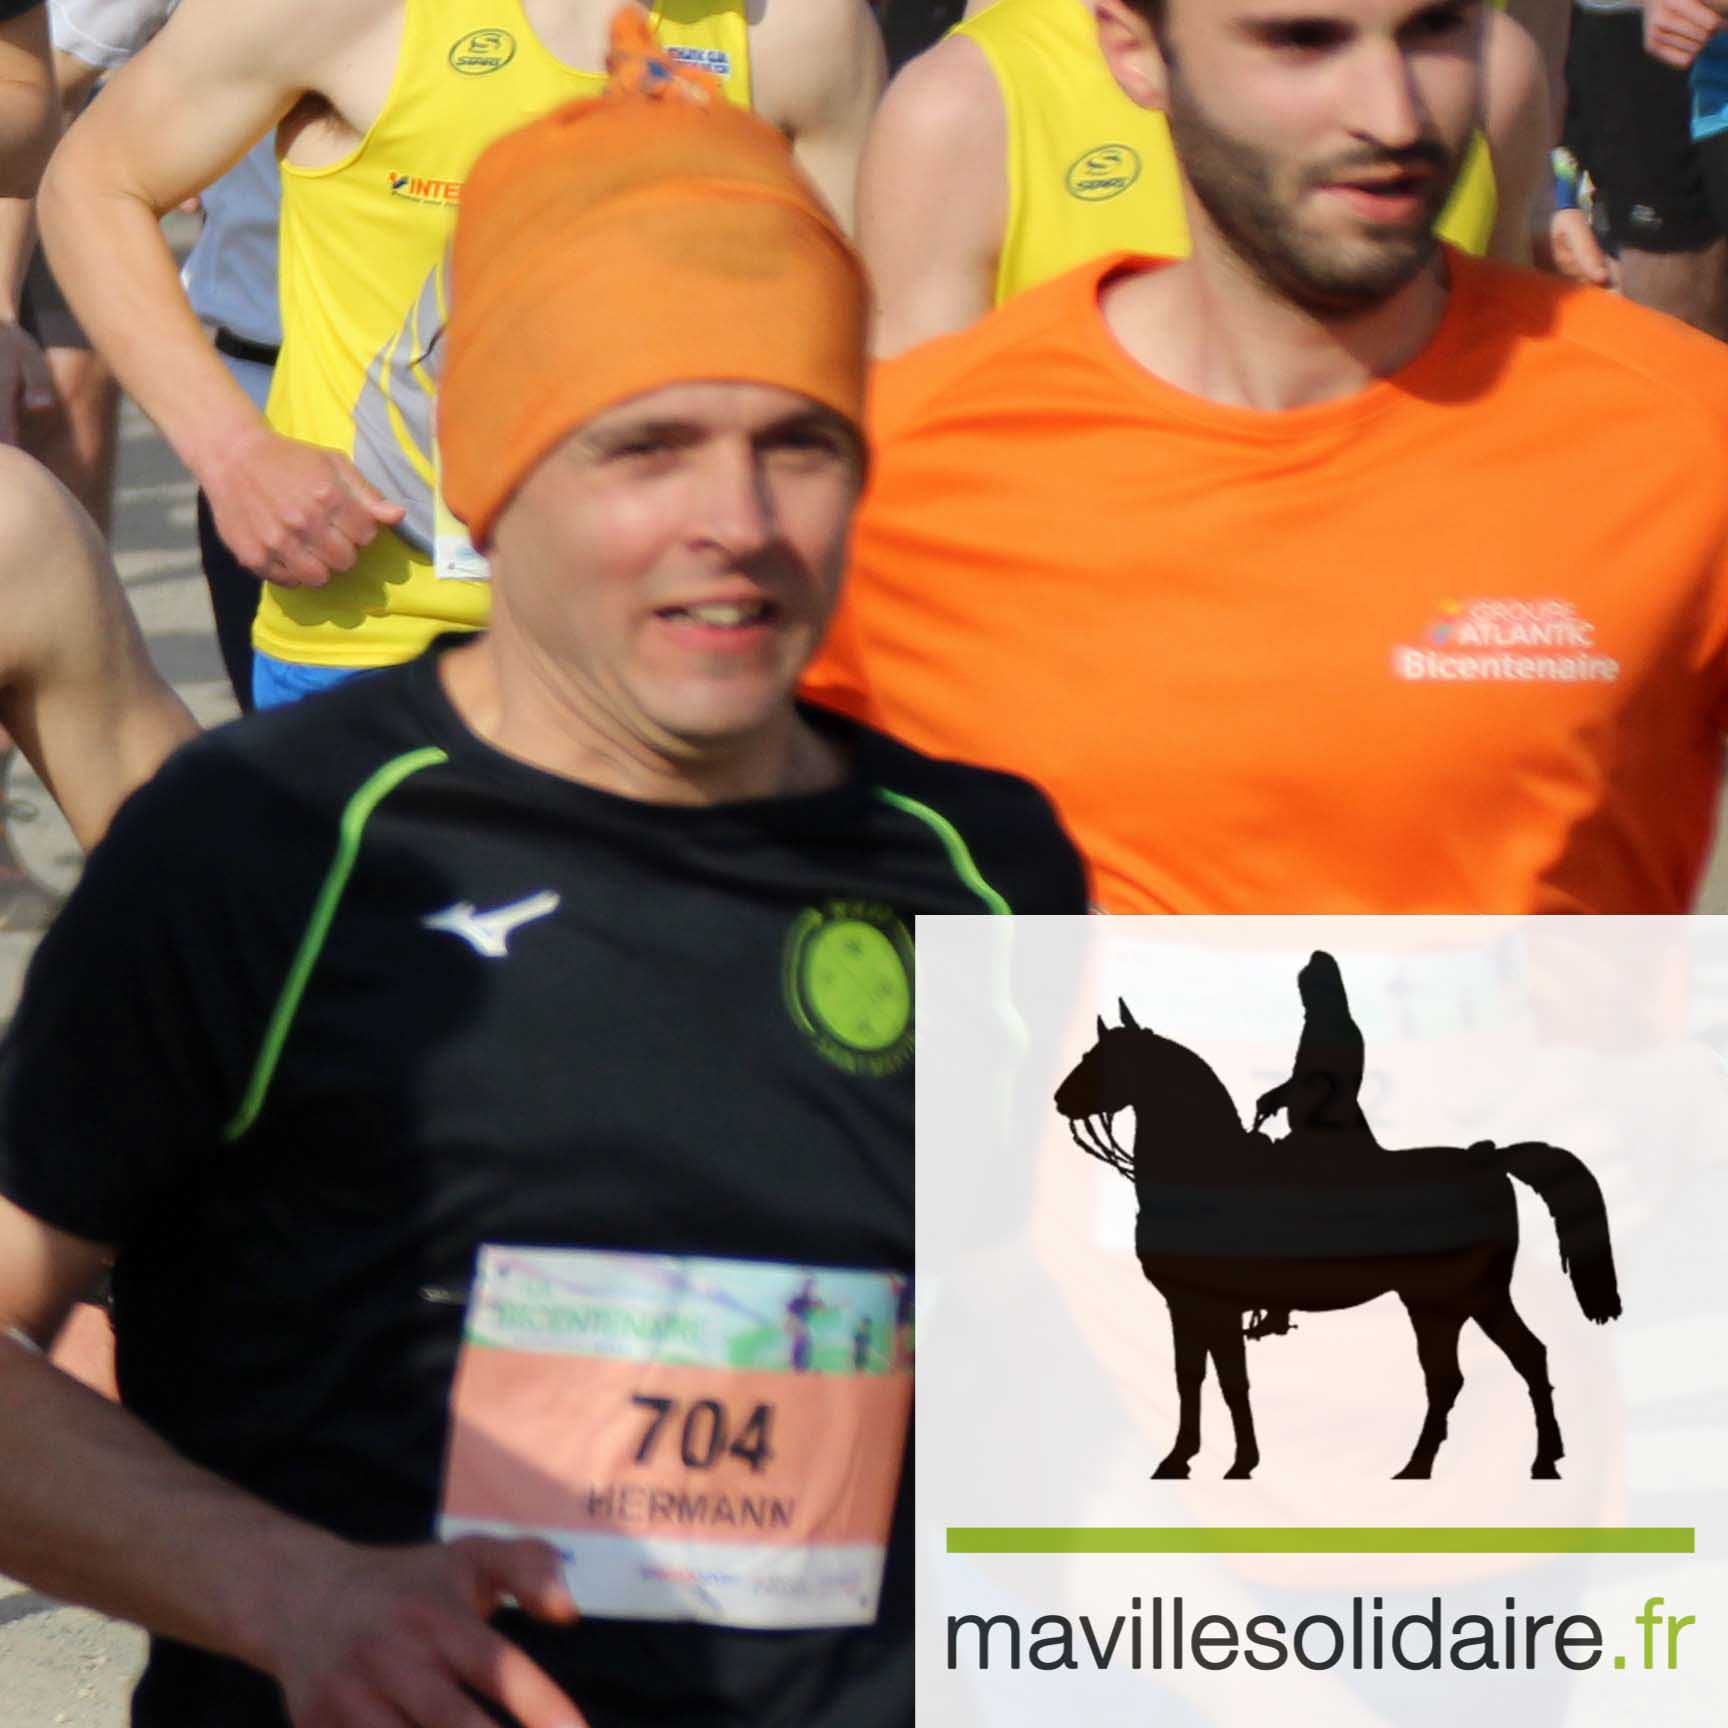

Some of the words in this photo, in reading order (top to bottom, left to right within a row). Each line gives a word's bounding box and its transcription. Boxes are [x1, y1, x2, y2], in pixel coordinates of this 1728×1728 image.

[1458, 623, 1597, 647] ATLANTIC
[1398, 650, 1622, 683] Bicentenaire
[630, 1393, 775, 1471] 704
[586, 1482, 796, 1529] HERMANN
